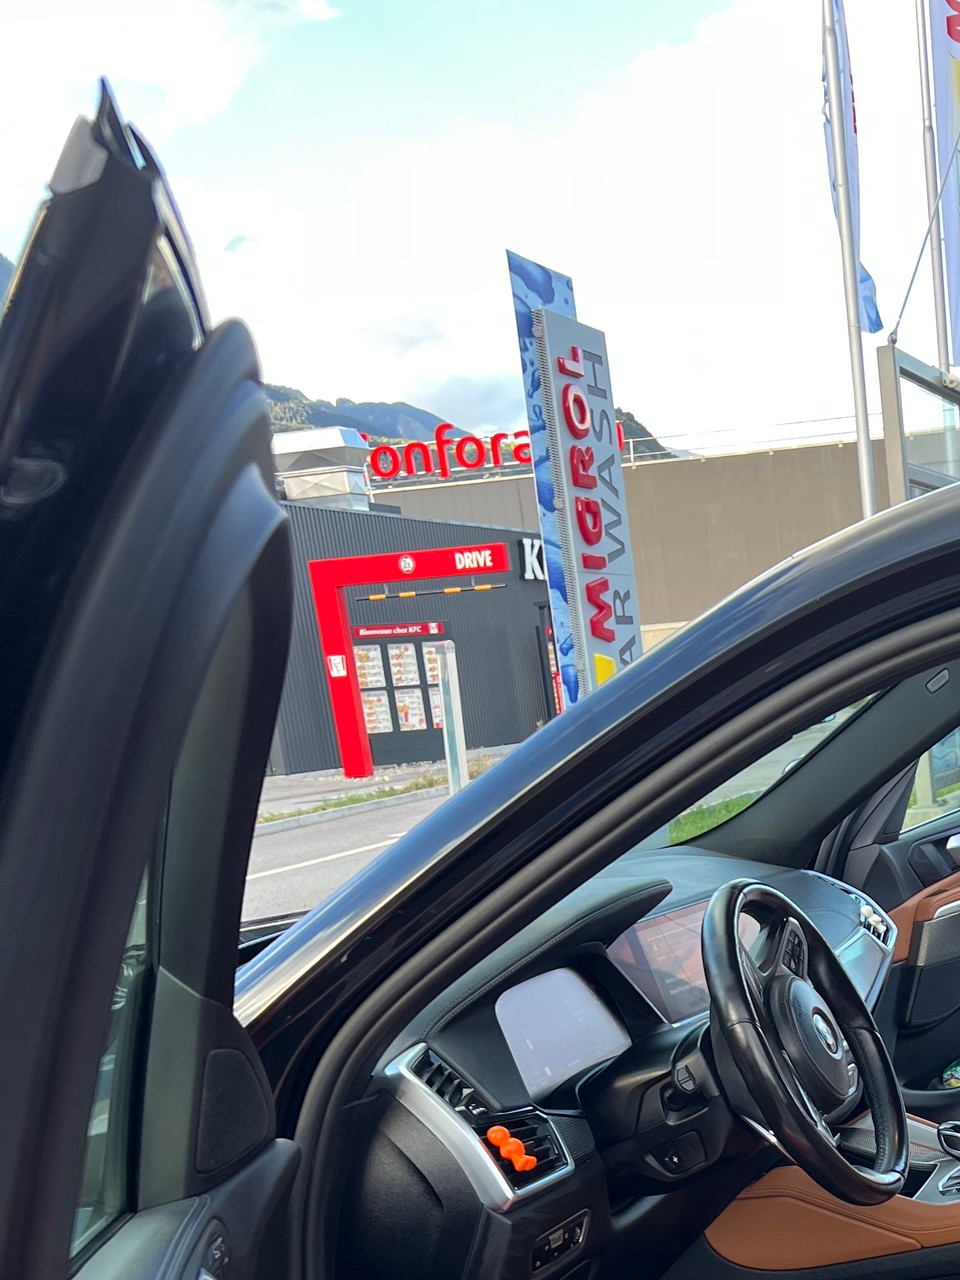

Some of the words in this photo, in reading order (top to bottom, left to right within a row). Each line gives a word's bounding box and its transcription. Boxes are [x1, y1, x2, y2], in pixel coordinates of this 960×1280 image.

[557, 345, 616, 643] MIGROL
[583, 349, 626, 563] WASH
[454, 549, 493, 570] DRIVE
[408, 625, 422, 634] KFC
[612, 588, 636, 668] AR
